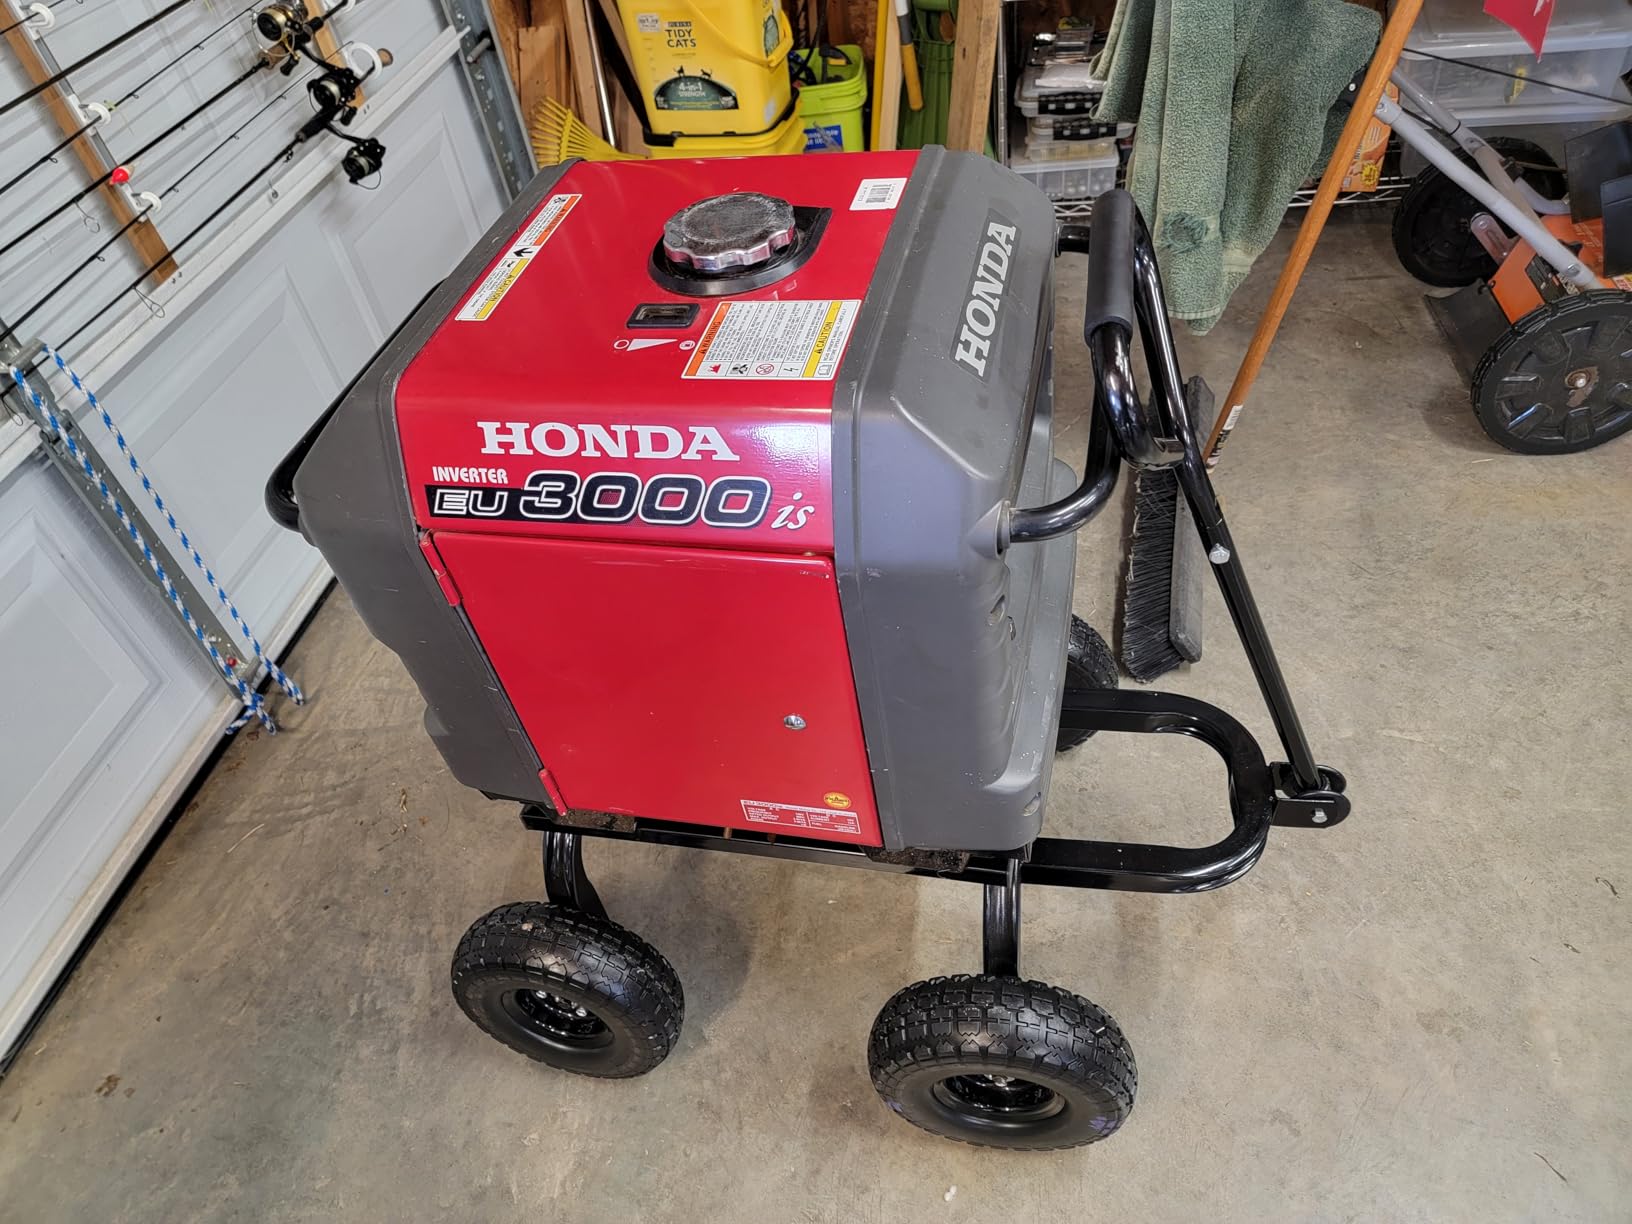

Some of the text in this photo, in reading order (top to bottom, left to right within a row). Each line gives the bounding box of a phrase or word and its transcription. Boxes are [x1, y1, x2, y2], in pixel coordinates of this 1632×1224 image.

[664, 29, 693, 38] TIDY
[667, 39, 697, 48] CATS
[955, 222, 1017, 377] HONDA
[702, 321, 722, 349] WARNING
[816, 321, 834, 348] CAUTION
[476, 421, 741, 461] HONDA
[432, 466, 508, 485] INVERTER
